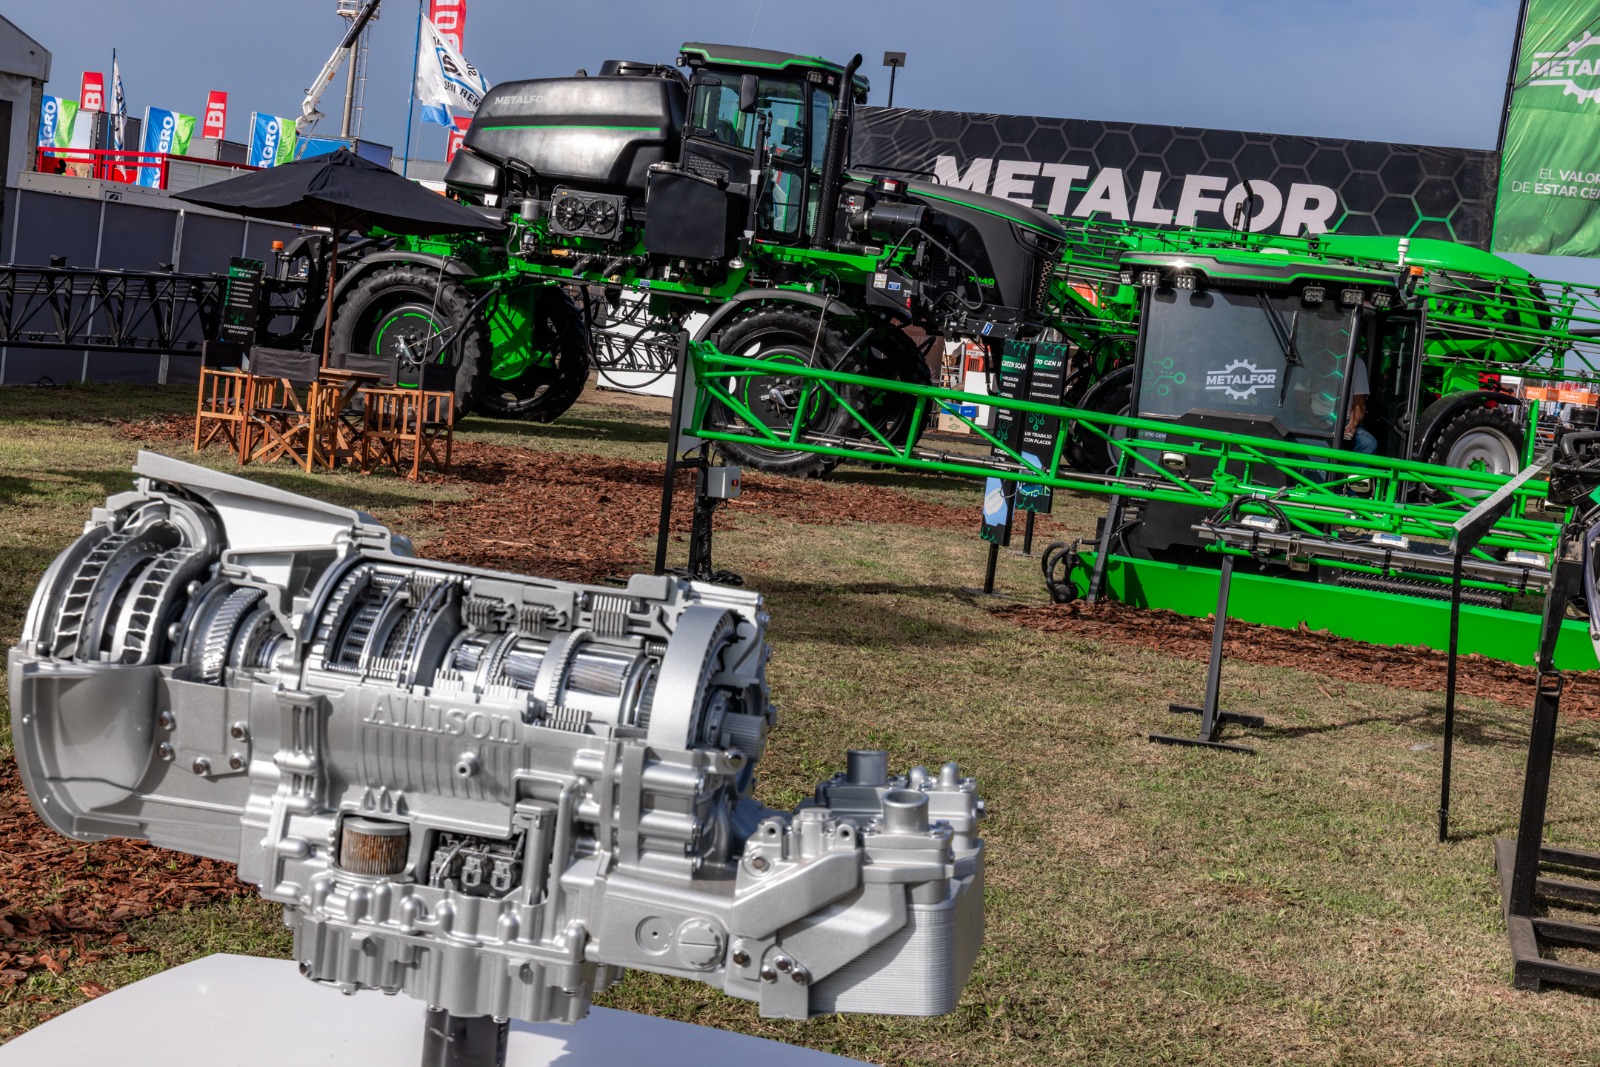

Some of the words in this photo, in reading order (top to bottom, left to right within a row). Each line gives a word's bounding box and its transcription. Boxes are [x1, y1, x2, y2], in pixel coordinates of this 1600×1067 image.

[1540, 168, 1556, 180] EL
[934, 155, 1337, 236] METALFOR
[1512, 180, 1531, 193] DE
[1534, 183, 1577, 197] ESTAR
[1044, 359, 1056, 367] GEN
[1205, 374, 1277, 386] METALFOR
[363, 692, 518, 745] Allison
